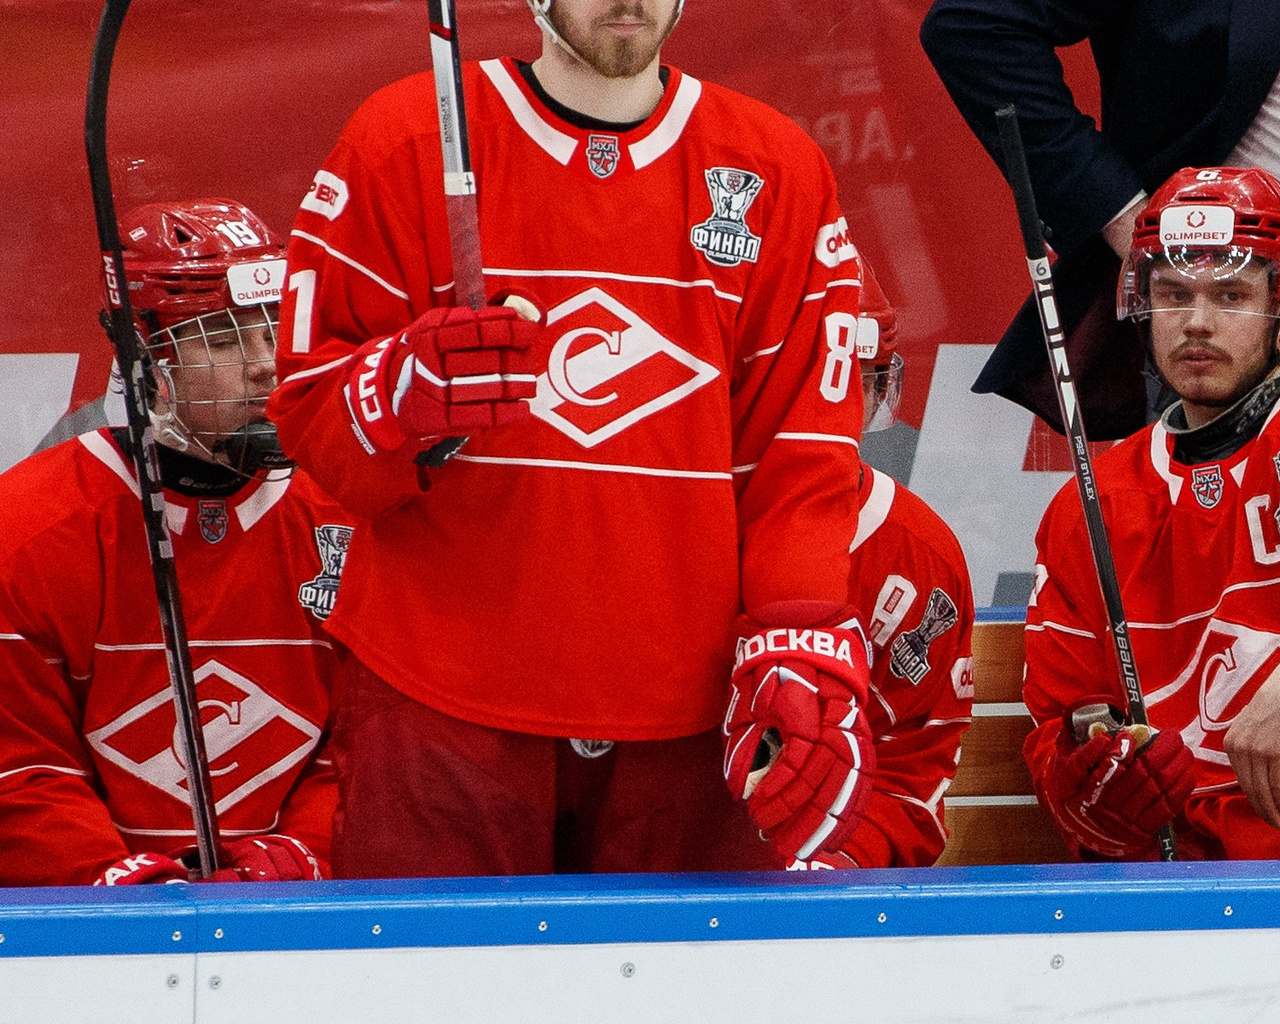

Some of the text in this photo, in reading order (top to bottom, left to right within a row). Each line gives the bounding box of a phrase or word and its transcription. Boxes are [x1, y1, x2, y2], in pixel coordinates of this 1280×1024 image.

[216, 220, 262, 249] 19
[693, 227, 759, 260] ФИНАЛ
[1164, 231, 1228, 242] OLIMPBET
[103, 255, 122, 306] CCM
[819, 311, 858, 404] 8
[740, 628, 855, 669] ОСКВА
[1115, 636, 1140, 704] BAUER
